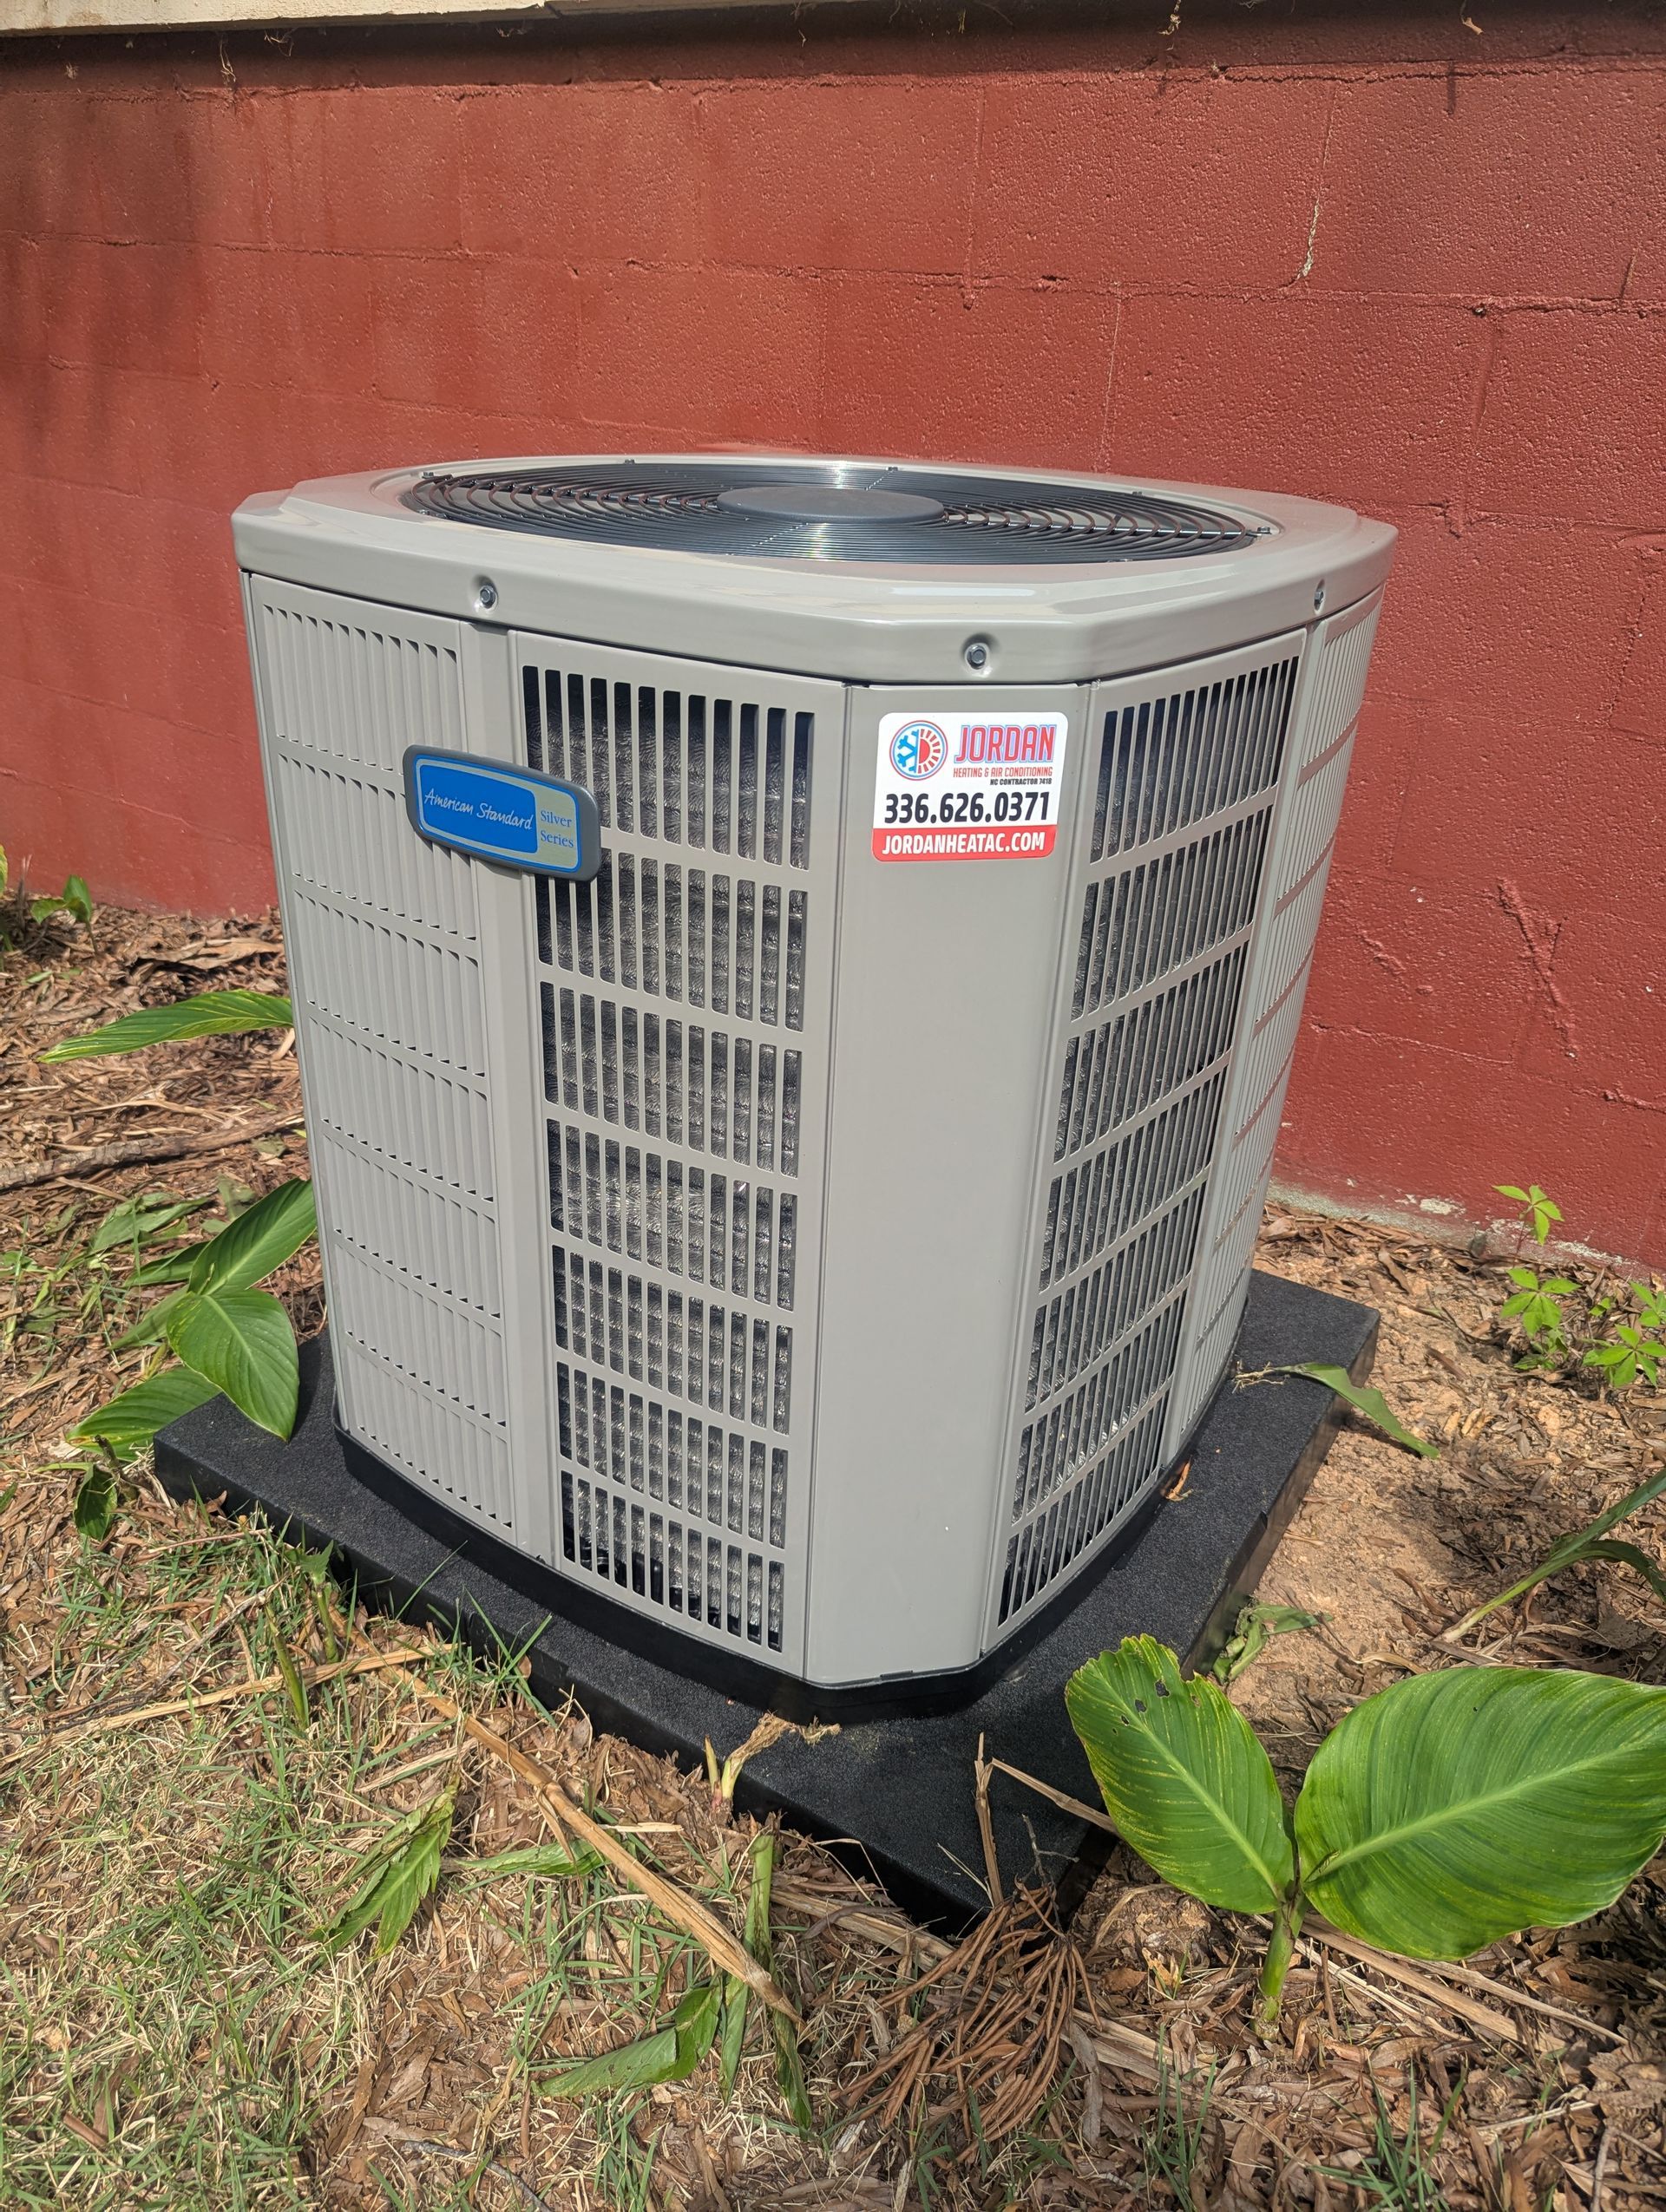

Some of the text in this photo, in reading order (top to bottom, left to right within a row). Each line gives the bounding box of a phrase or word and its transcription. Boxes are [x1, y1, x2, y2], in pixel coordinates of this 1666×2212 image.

[954, 724, 1057, 763] JORDAN
[953, 766, 1053, 778] HEATING & AIR CONDITIONING
[1000, 777, 1039, 786] CONTRACTOR
[424, 788, 534, 830] American Standard
[884, 791, 1050, 823] 336.626.0371
[540, 809, 573, 828] Silver
[540, 829, 574, 848] Series
[882, 831, 1046, 855] JORDANHEATAC.COM
